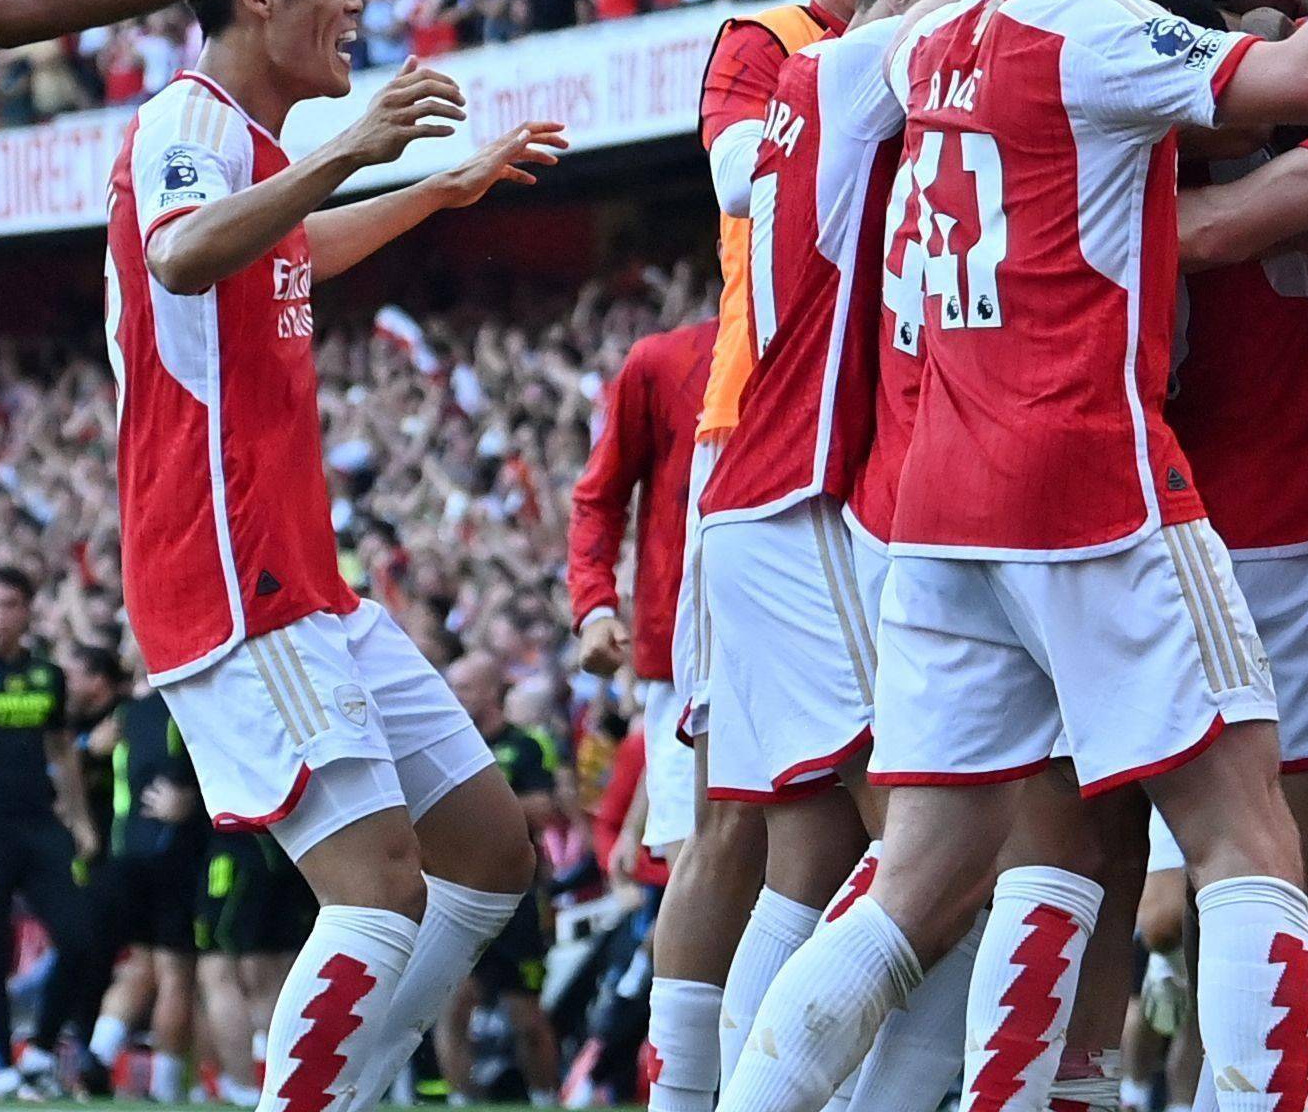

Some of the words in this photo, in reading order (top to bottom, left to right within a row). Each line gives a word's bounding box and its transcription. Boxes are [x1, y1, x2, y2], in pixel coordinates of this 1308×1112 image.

[763, 99, 807, 159] IRA
[923, 67, 984, 113] RICE
[749, 170, 780, 361] 1
[911, 130, 1009, 330] 41
